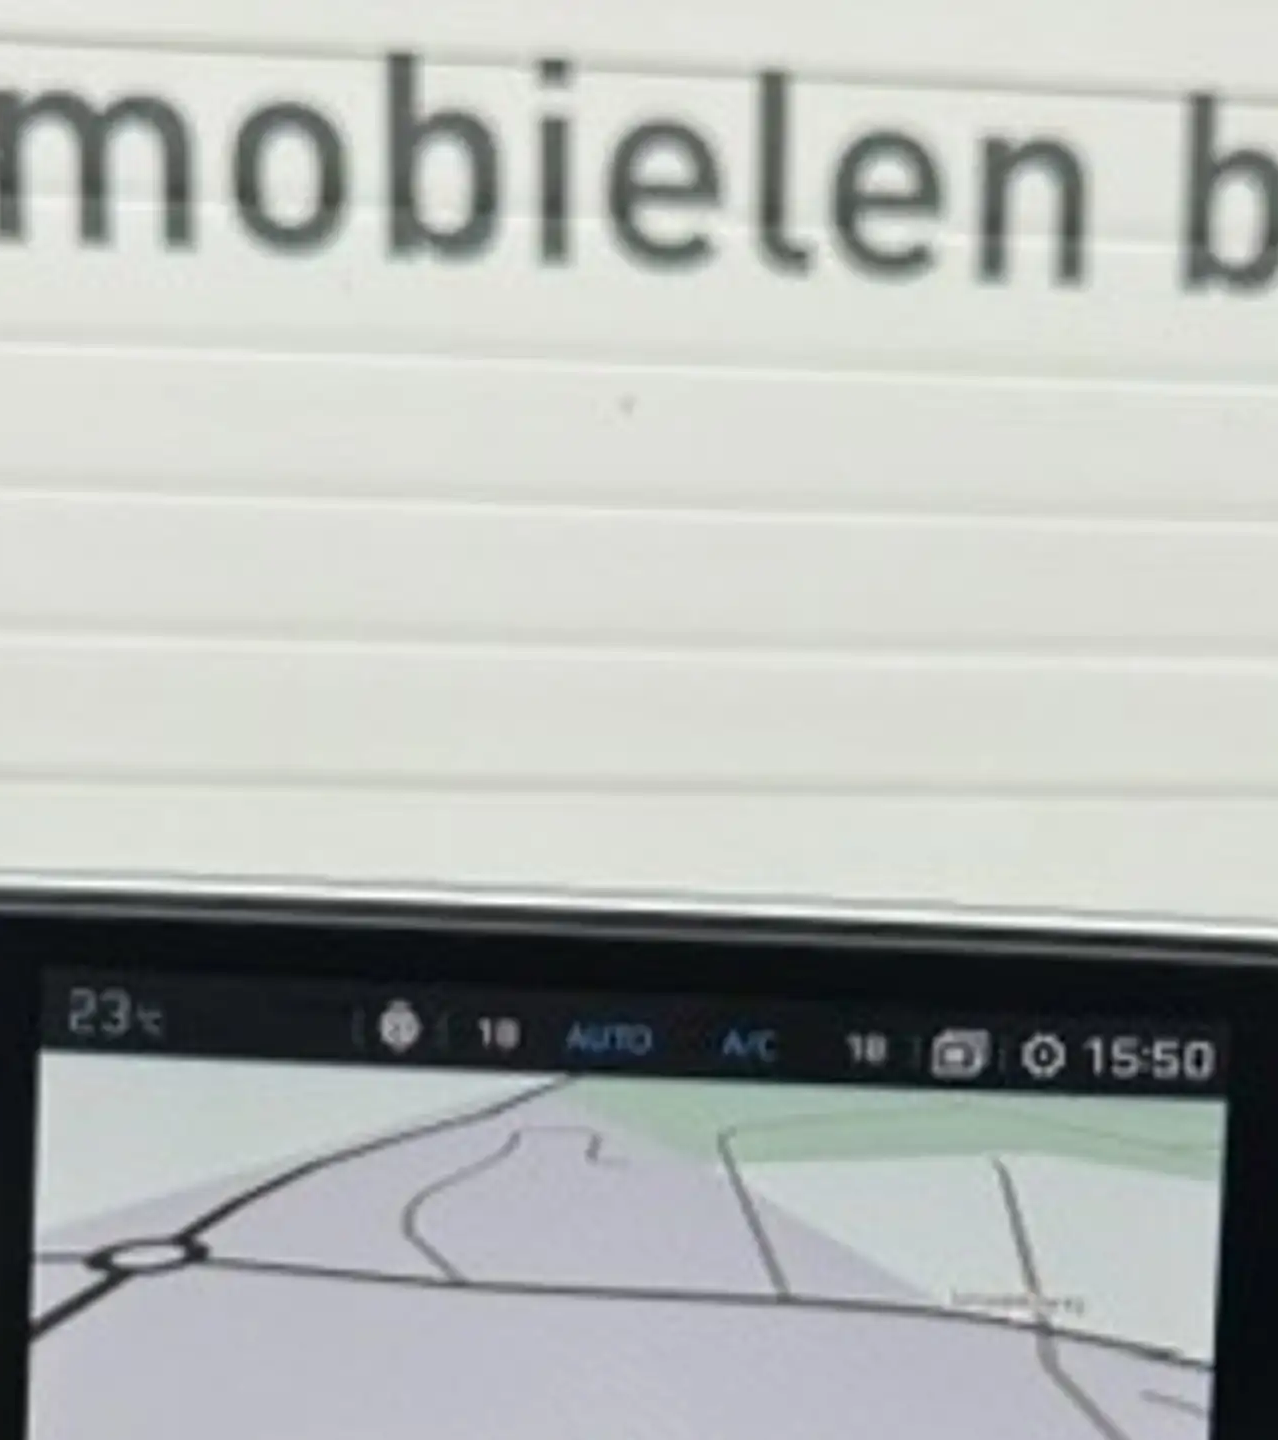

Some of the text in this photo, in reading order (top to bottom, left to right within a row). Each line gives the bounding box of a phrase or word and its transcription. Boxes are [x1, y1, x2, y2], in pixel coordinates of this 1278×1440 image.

[565, 1020, 653, 1056] AUTO
[722, 1026, 778, 1062] A/C
[1084, 1034, 1216, 1079] 15:50
